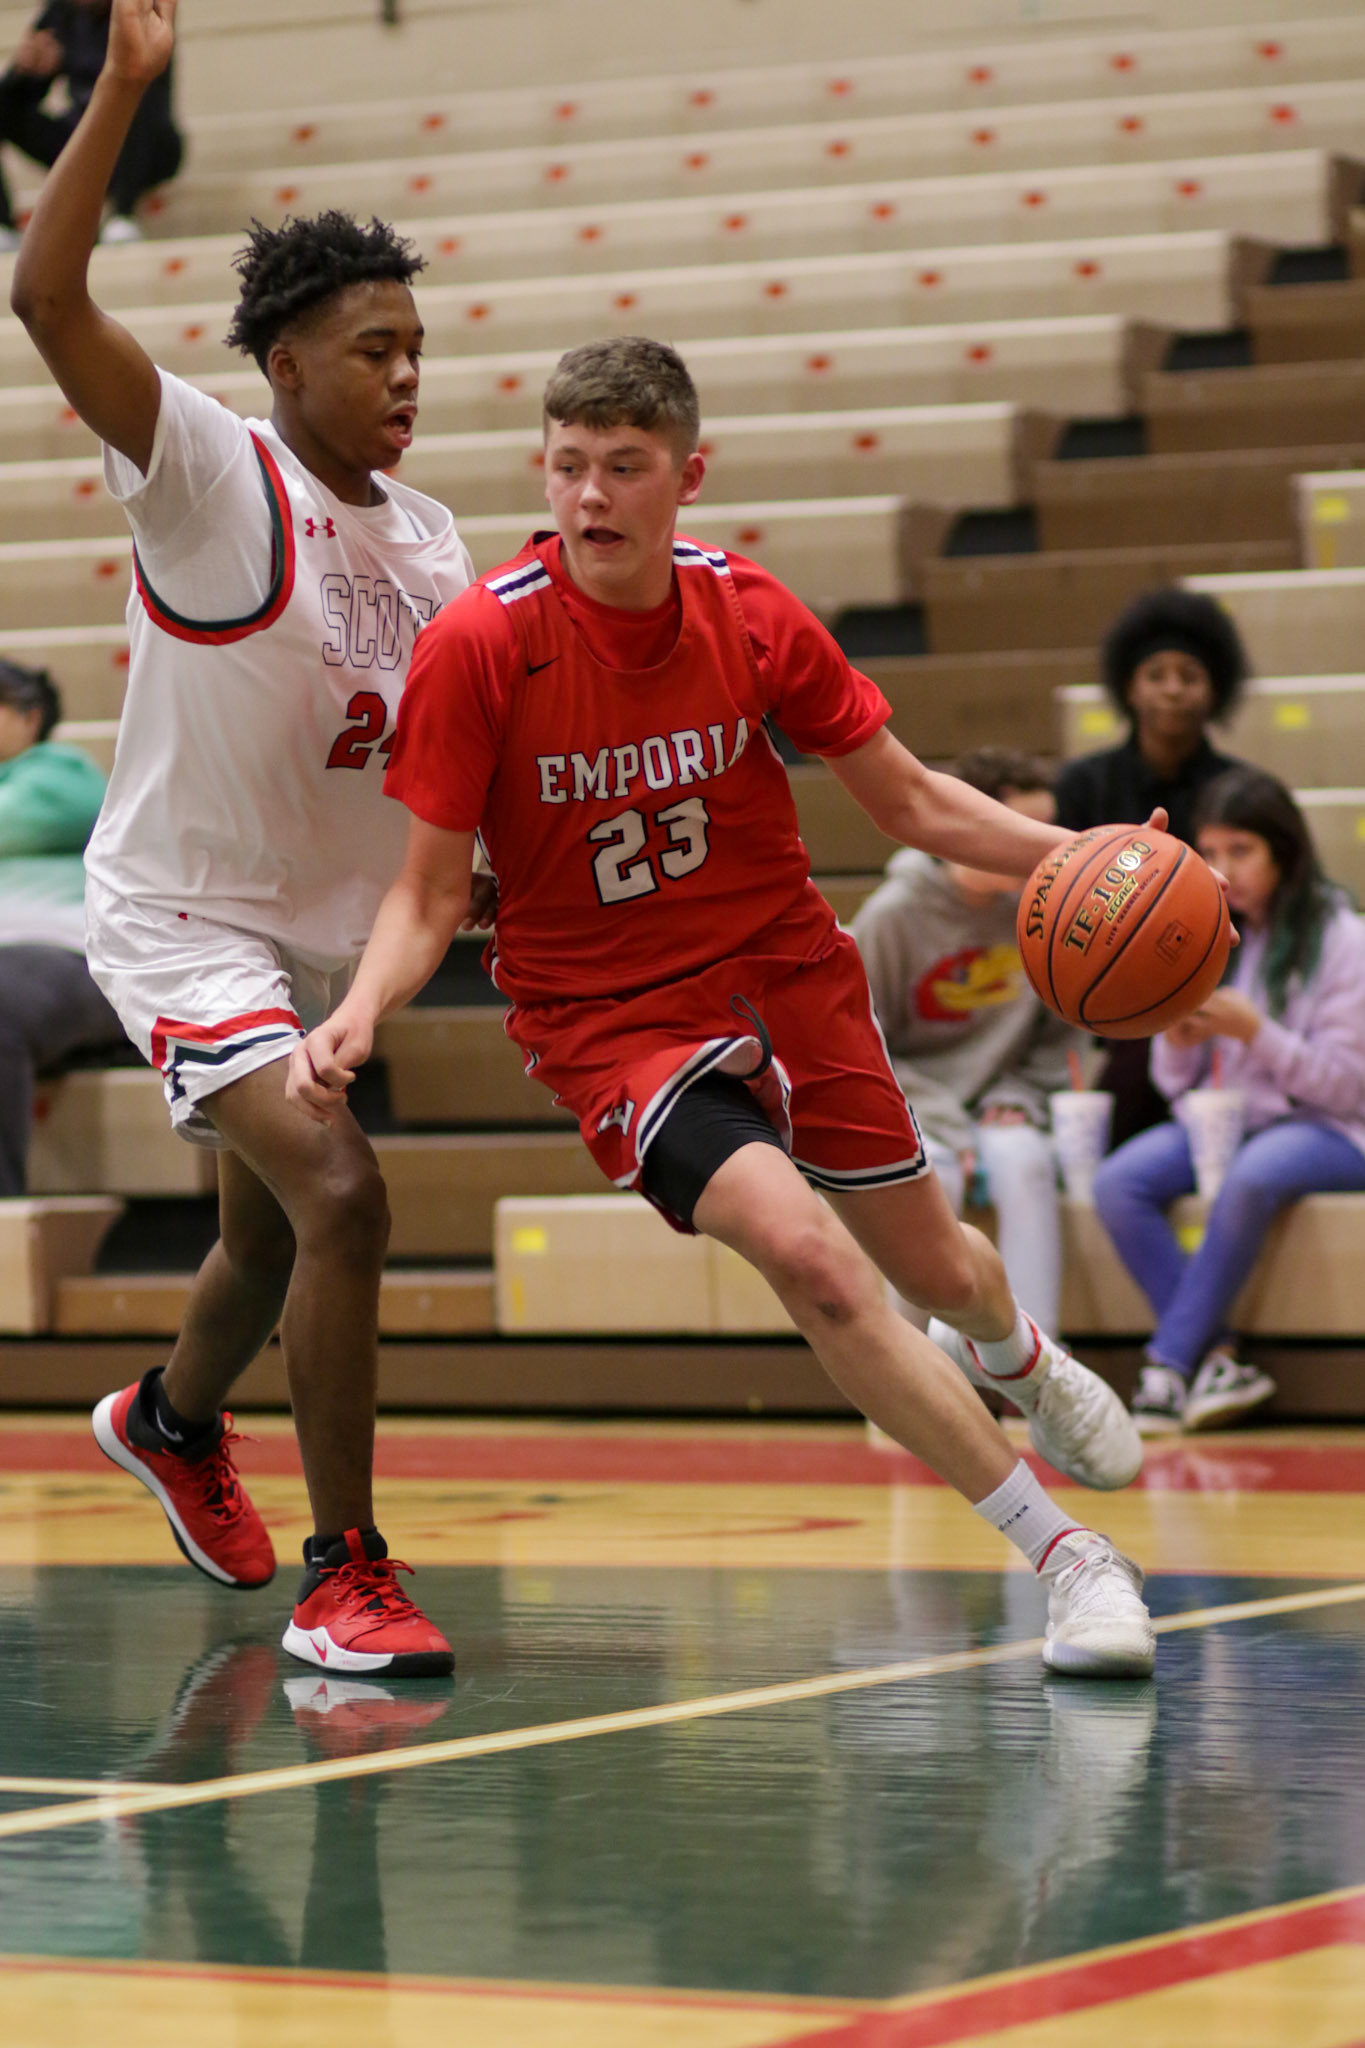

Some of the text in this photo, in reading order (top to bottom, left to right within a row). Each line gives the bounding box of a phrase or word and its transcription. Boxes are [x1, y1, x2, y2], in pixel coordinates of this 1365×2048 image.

[320, 574, 442, 670] SCOT
[536, 716, 749, 804] EMPORIA
[587, 796, 711, 906] 23
[1064, 840, 1152, 951] TF-1000
[1104, 876, 1138, 922] LEGACY
[1118, 891, 1139, 924] CHANNEL
